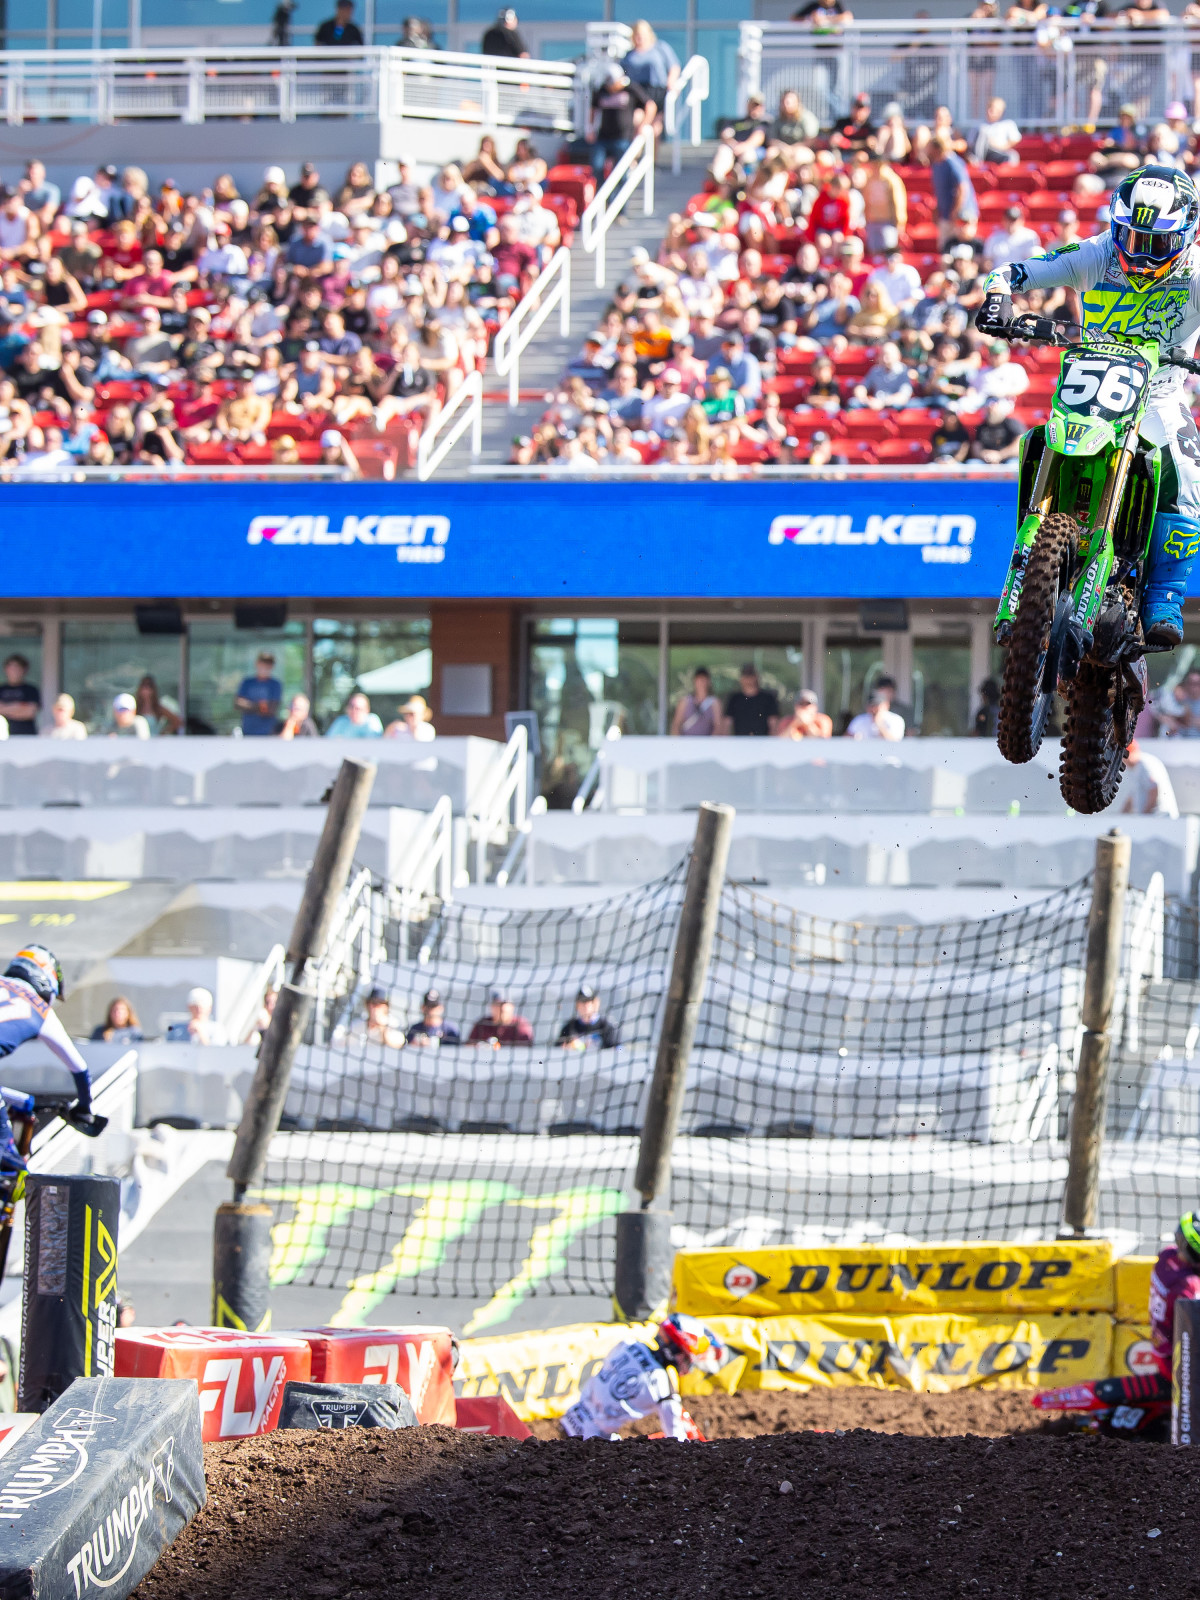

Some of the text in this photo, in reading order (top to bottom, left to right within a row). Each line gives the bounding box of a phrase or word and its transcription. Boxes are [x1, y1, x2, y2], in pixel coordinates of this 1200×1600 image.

[986, 296, 1002, 323] FOX
[1061, 360, 1144, 412] 56
[246, 515, 451, 545] FALKEN
[768, 514, 977, 545] FALKEN
[21, 1215, 32, 1338] CHAMPIONSHIP
[780, 1260, 1072, 1294] DUNLOP
[96, 1300, 111, 1377] UPER
[754, 1340, 1091, 1376] DUNLOP
[18, 1342, 26, 1398] WORLD
[453, 1358, 603, 1403] UNLO
[1181, 1331, 1191, 1431] CHAMPIONSHIP
[199, 1356, 284, 1438] FLY
[321, 1404, 357, 1412] TRIUMPH
[67, 1466, 156, 1600] TRIUMPH
